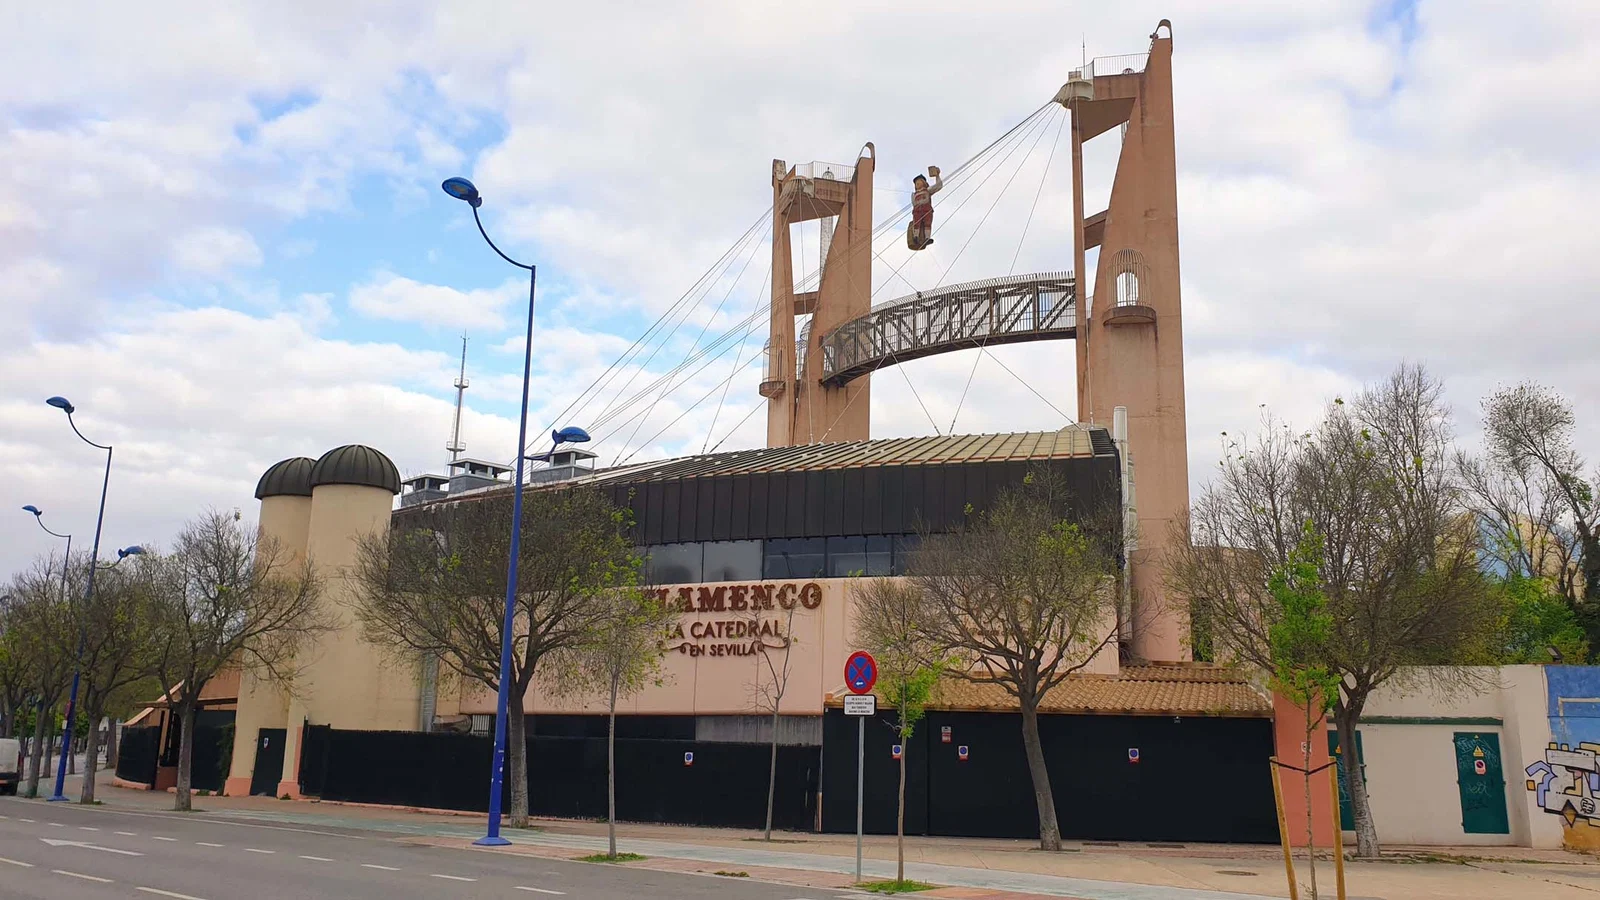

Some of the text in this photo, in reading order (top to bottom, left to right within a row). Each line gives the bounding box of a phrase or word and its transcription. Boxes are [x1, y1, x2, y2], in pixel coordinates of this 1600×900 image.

[690, 620, 783, 639] CATEDRAL
[689, 642, 757, 658] EN SEVILLA
